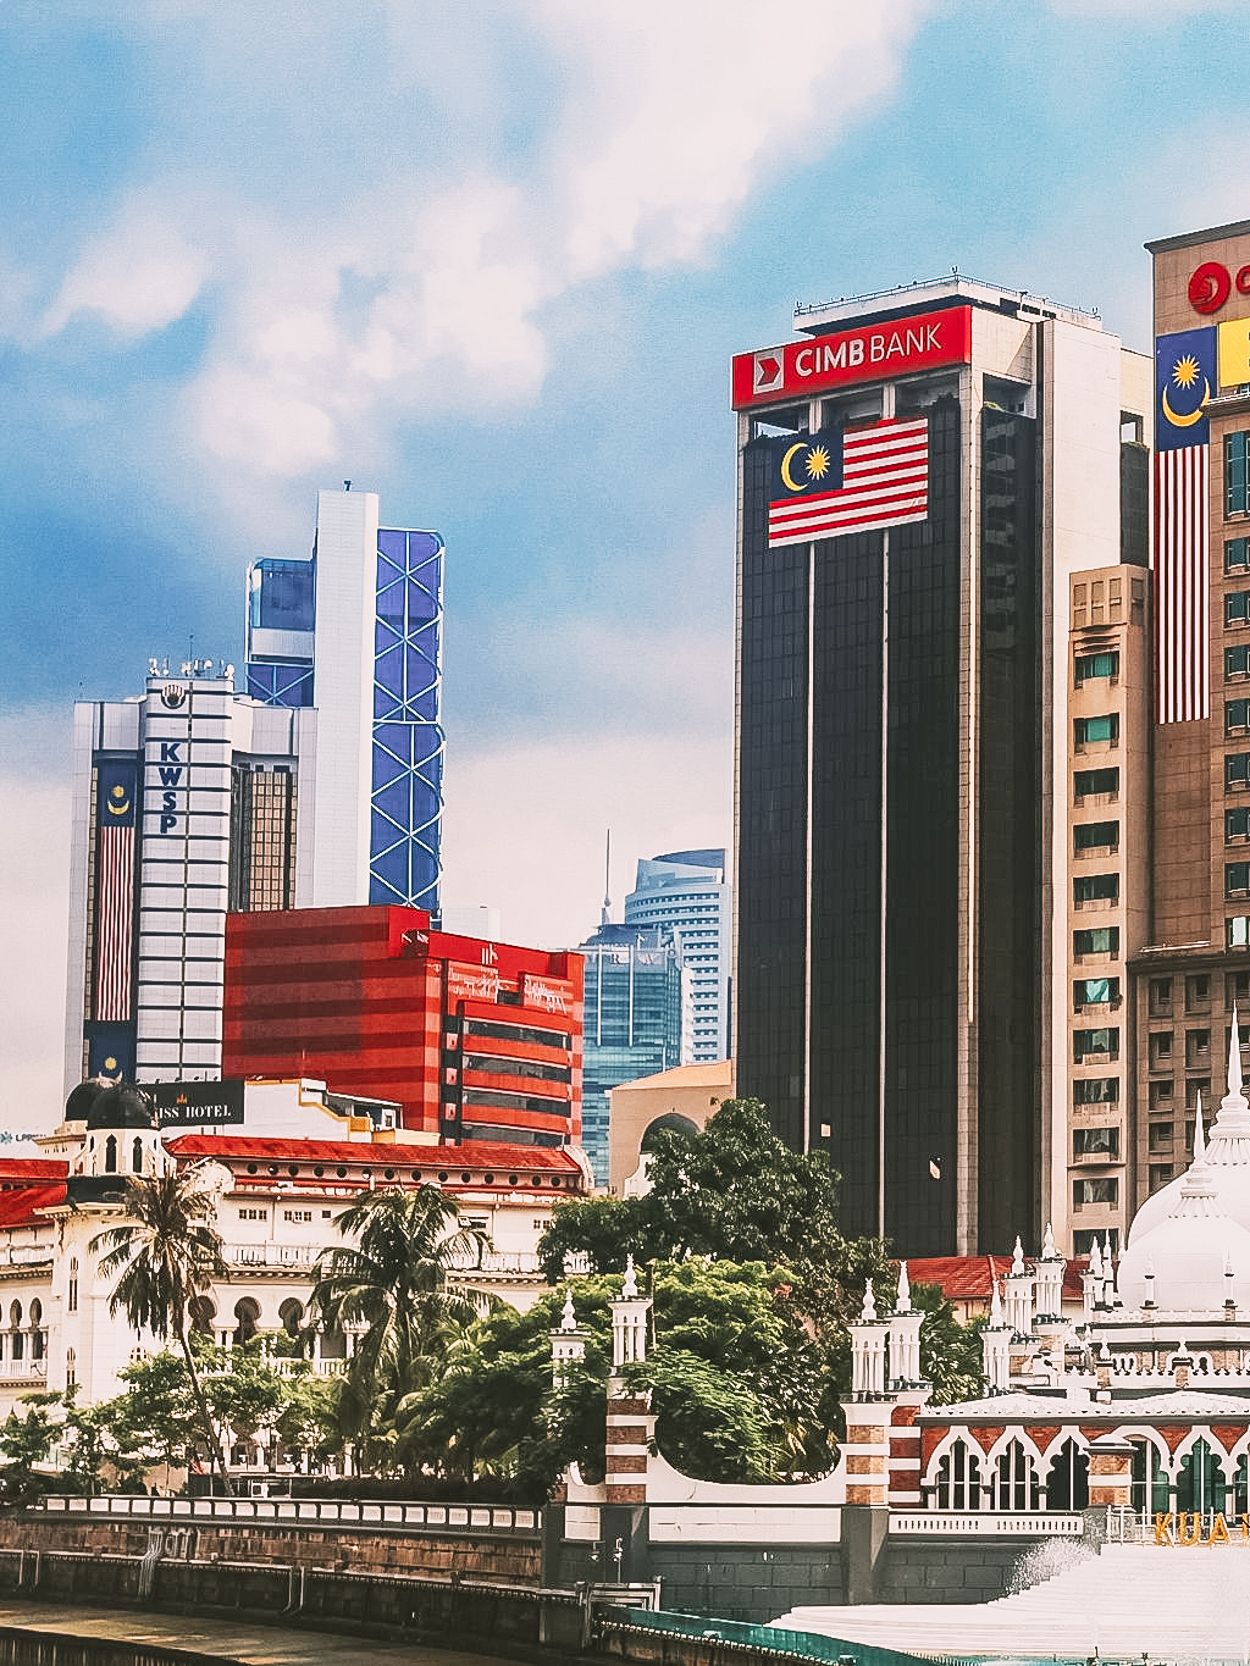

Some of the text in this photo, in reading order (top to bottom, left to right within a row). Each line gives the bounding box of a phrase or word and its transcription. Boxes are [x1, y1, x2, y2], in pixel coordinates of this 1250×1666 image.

[795, 322, 942, 377] CIMB BANK
[158, 742, 182, 834] KWSP
[185, 1104, 232, 1118] HOTEL
